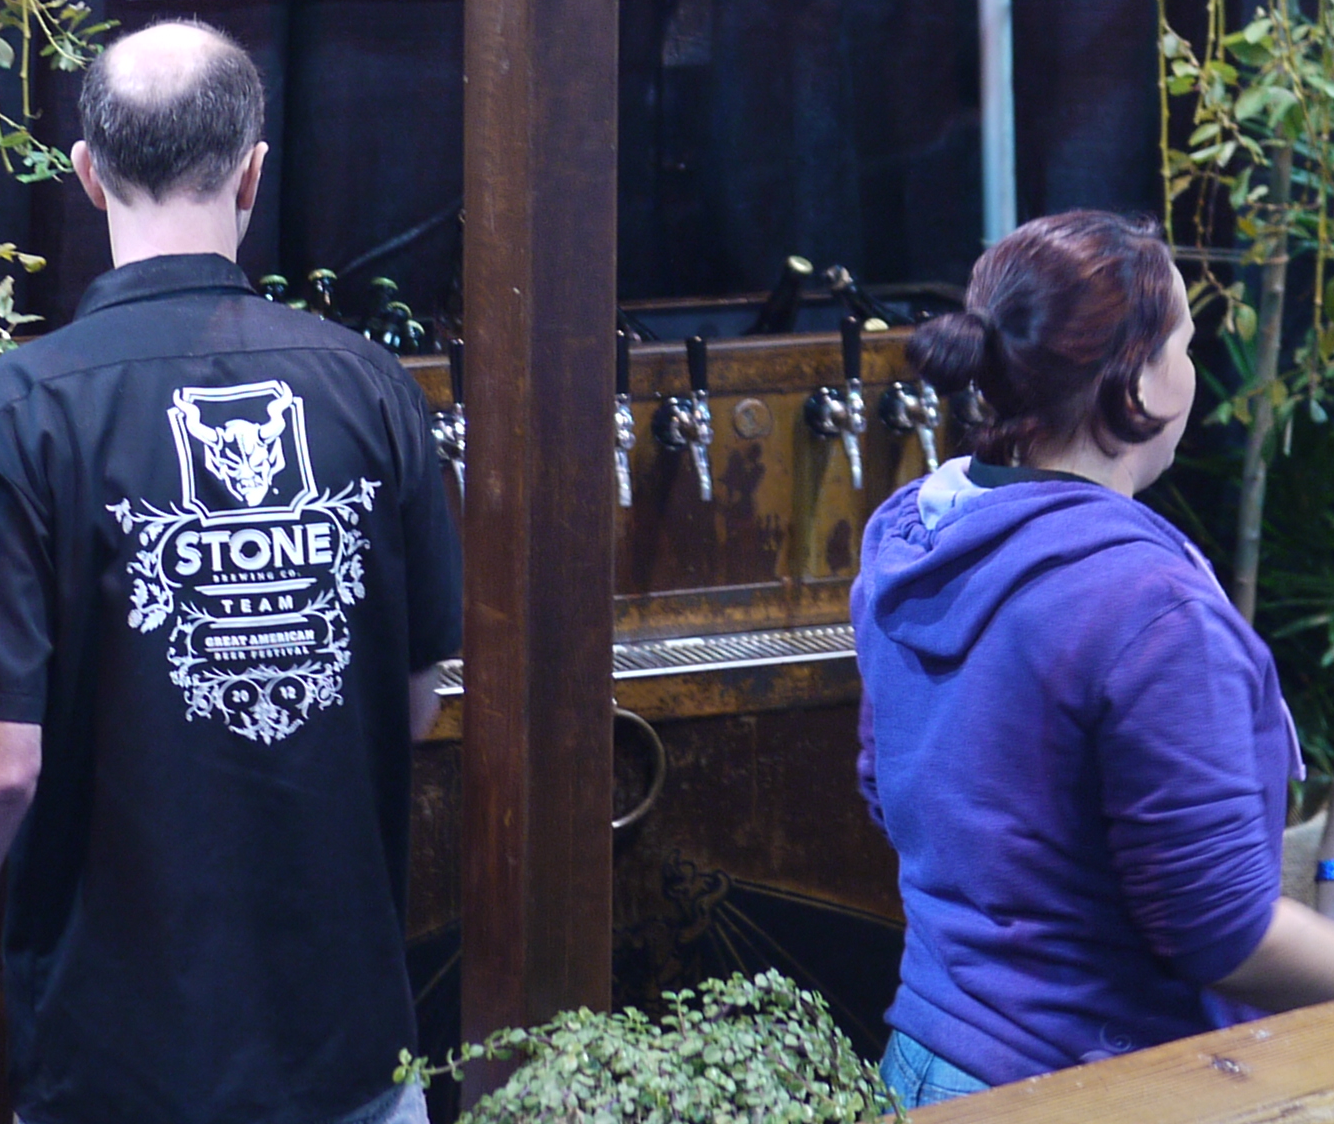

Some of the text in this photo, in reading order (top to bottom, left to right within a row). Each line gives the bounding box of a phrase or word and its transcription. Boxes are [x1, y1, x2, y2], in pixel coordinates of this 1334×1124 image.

[175, 523, 333, 576] STONE
[221, 595, 294, 614] TEAM
[204, 629, 315, 648] GREAT AMERICAN
[231, 689, 250, 703] 20
